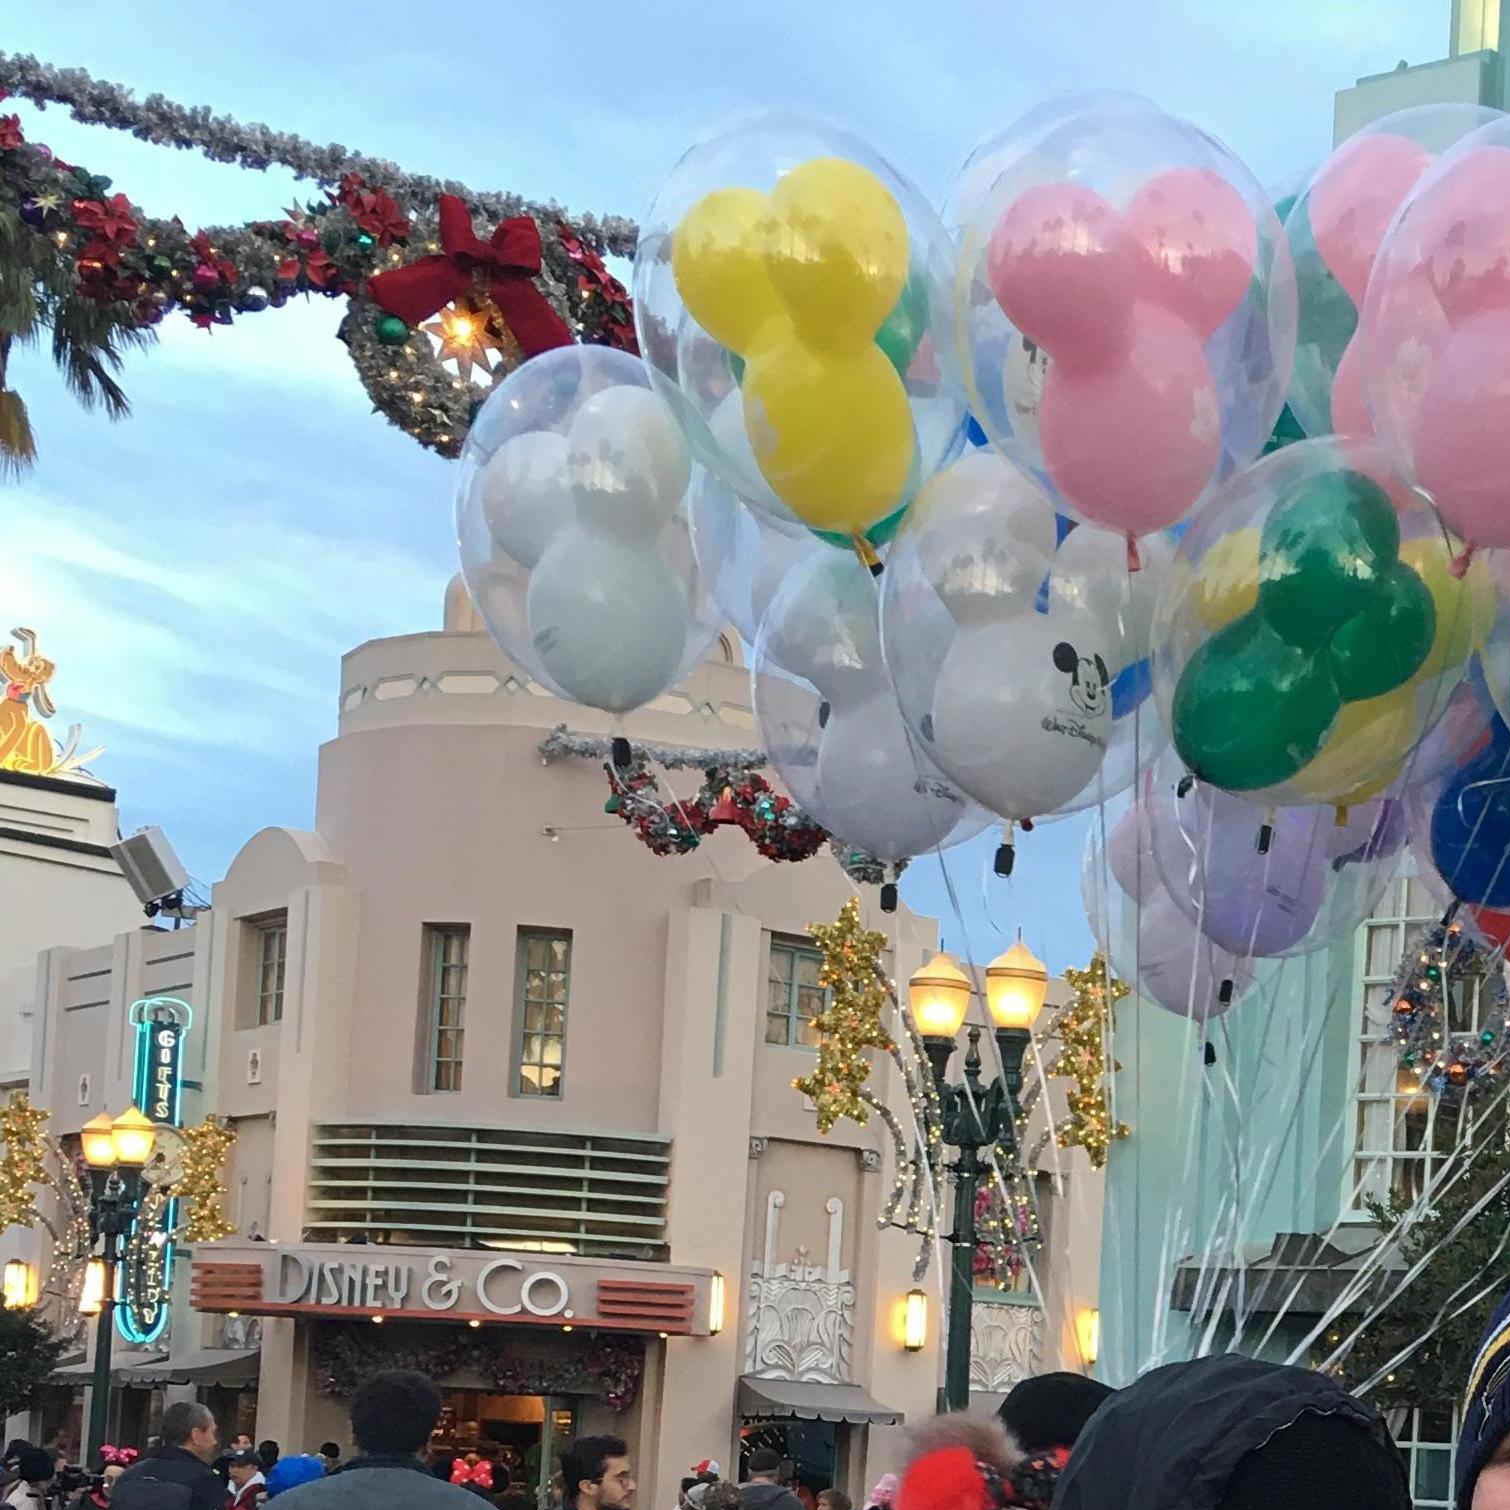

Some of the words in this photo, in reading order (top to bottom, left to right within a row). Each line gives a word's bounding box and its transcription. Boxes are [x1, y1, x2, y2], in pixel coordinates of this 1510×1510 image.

[155, 1030, 176, 1118] GIFTS
[277, 1253, 410, 1309] DISNEY
[421, 1255, 464, 1311] &
